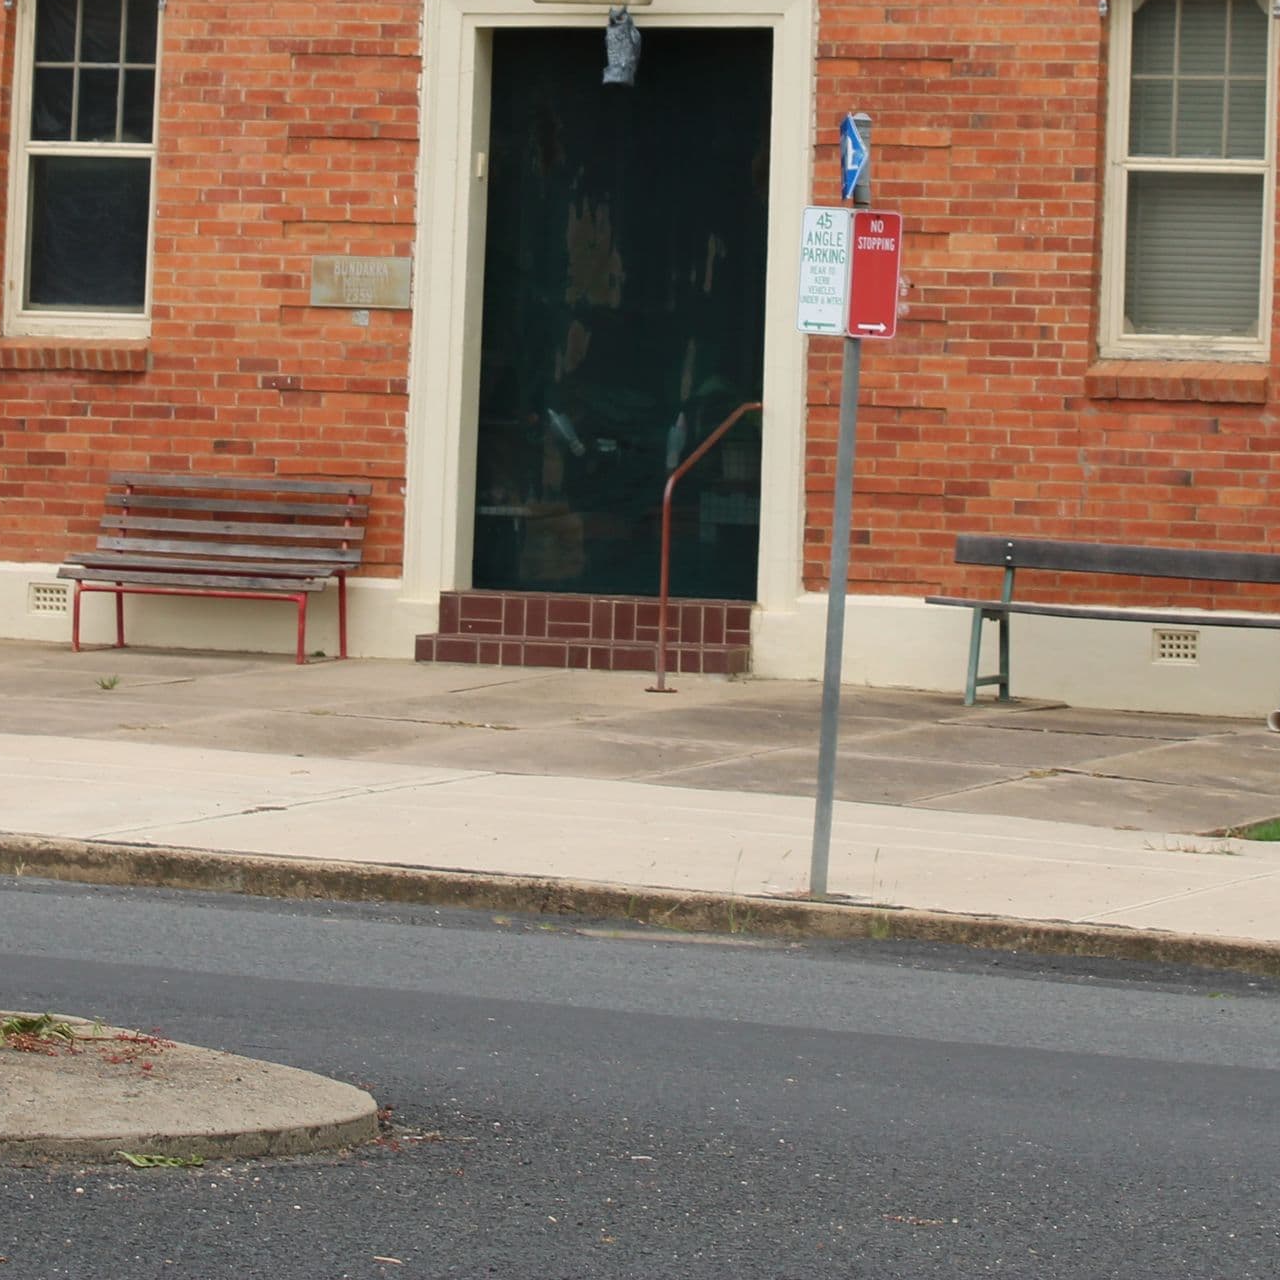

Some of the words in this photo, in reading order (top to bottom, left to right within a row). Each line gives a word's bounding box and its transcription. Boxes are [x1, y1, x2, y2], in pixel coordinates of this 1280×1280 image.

[816, 212, 833, 230] 45
[870, 219, 884, 233] NO
[806, 231, 844, 247] ANGLE
[857, 236, 896, 252] STOPPING
[801, 247, 846, 264] PARKING
